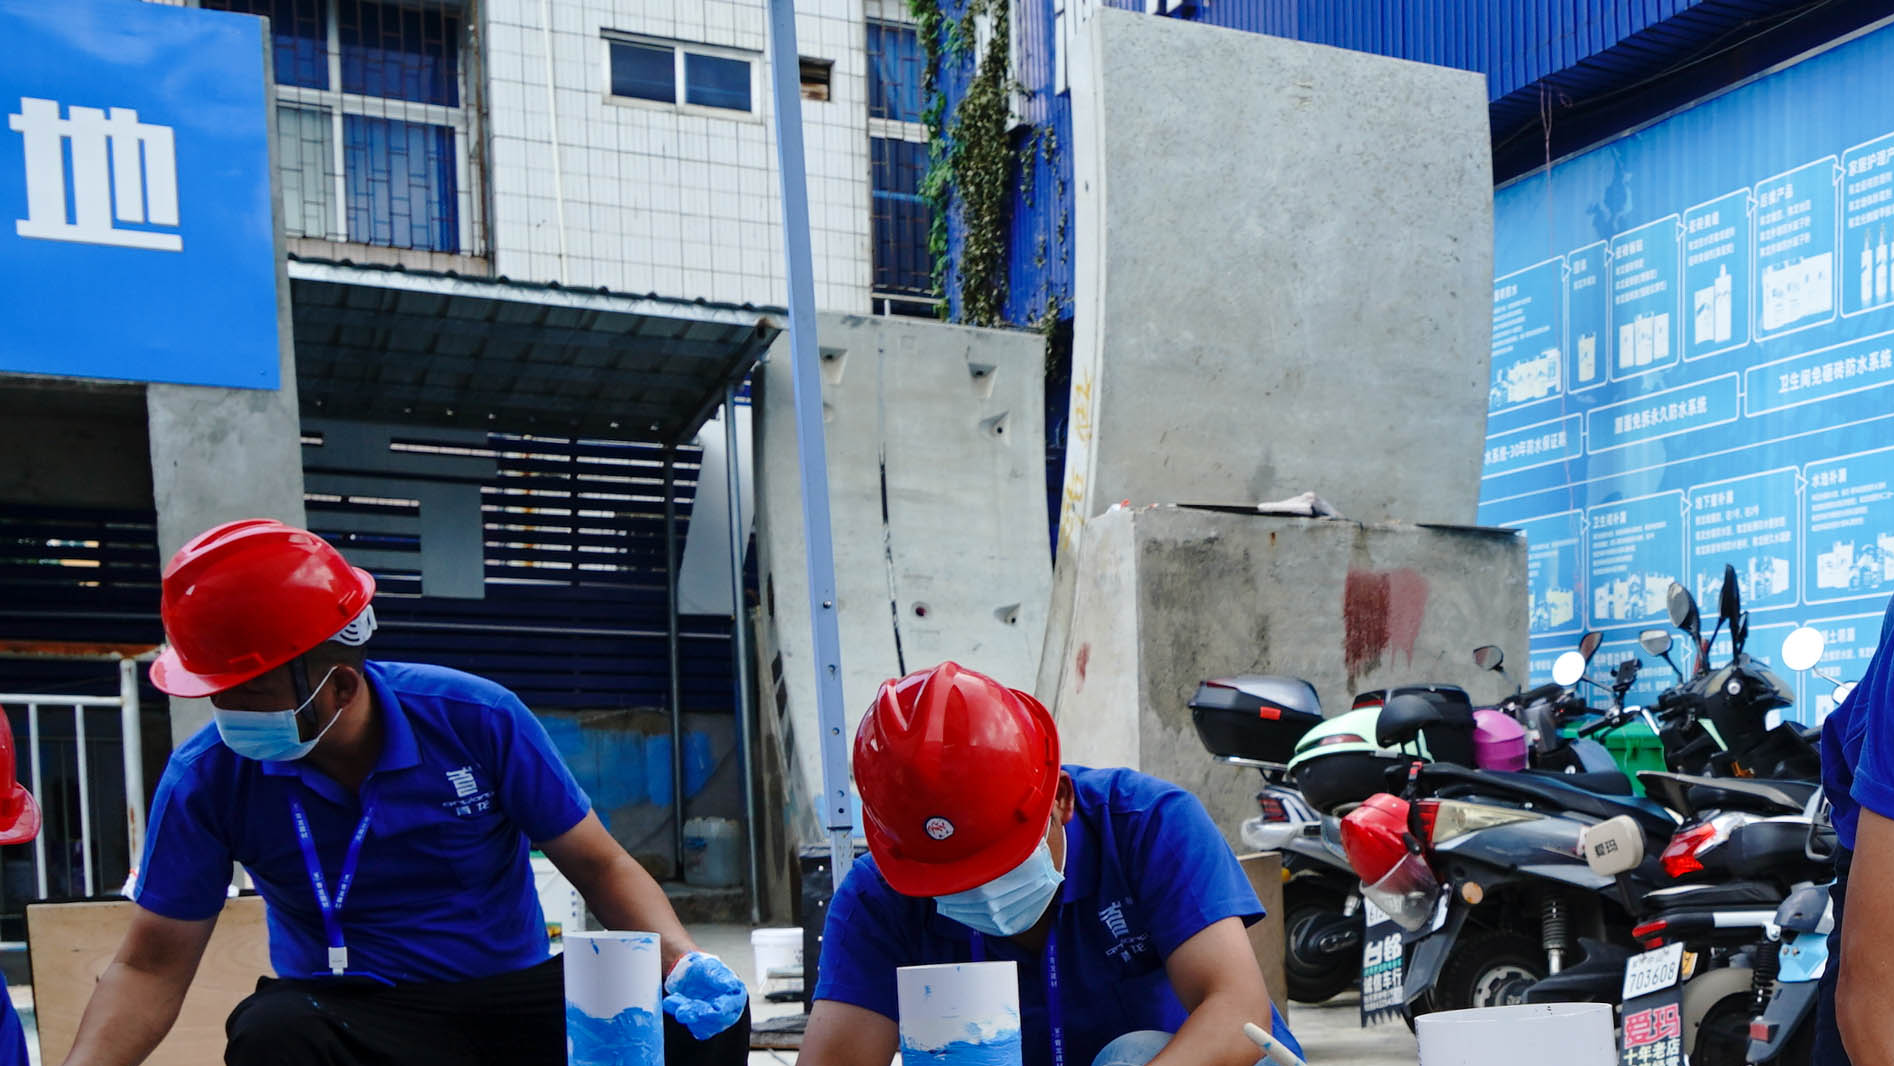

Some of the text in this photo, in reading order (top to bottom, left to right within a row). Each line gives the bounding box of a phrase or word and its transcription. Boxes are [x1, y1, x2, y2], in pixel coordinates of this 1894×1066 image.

[1630, 962, 1675, 992] 703608
[1624, 1003, 1681, 1049] 爱玛
[1623, 1037, 1681, 1066] 十年老店
